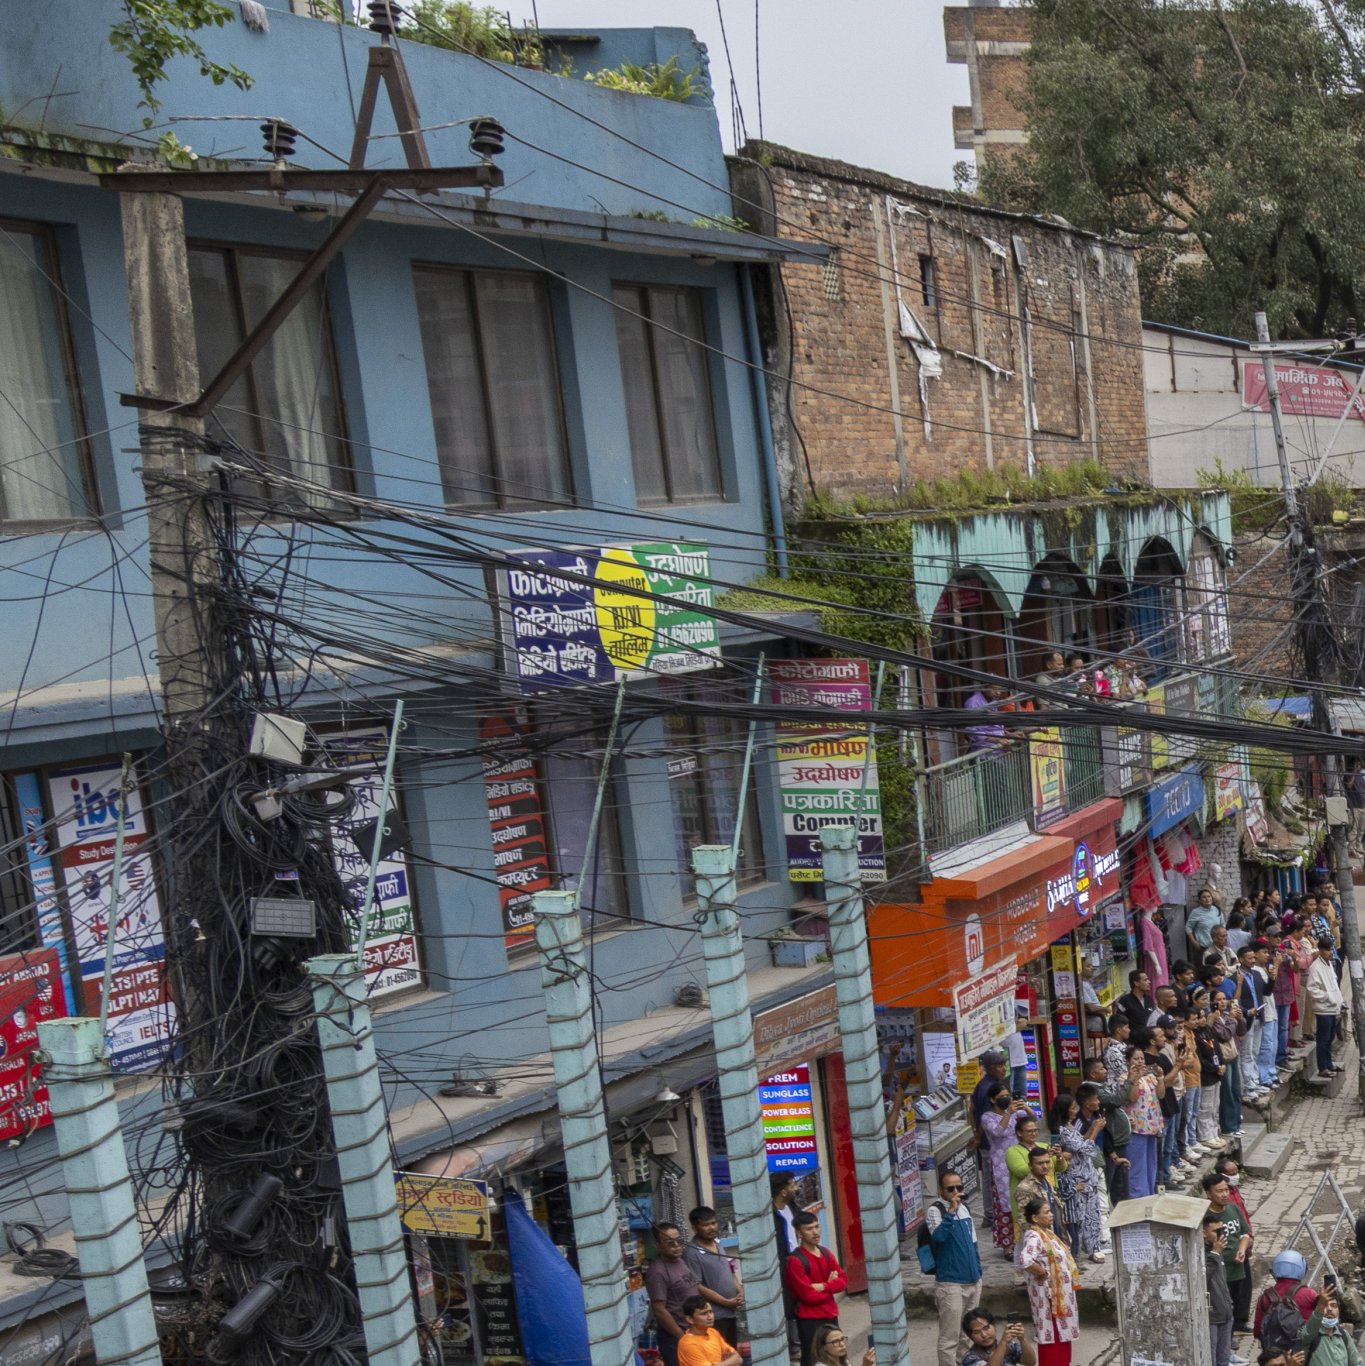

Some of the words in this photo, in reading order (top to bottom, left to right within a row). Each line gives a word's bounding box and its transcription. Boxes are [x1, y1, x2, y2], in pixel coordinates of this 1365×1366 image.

[762, 1087, 810, 1099] SUNGLASS
[762, 1108, 788, 1120] POWER
[788, 1106, 812, 1118] GLASS
[763, 1124, 792, 1136] CONTACT
[792, 1122, 813, 1134] LENCE
[765, 1141, 814, 1155] SOLUTION
[775, 1157, 808, 1167] REPAIR
